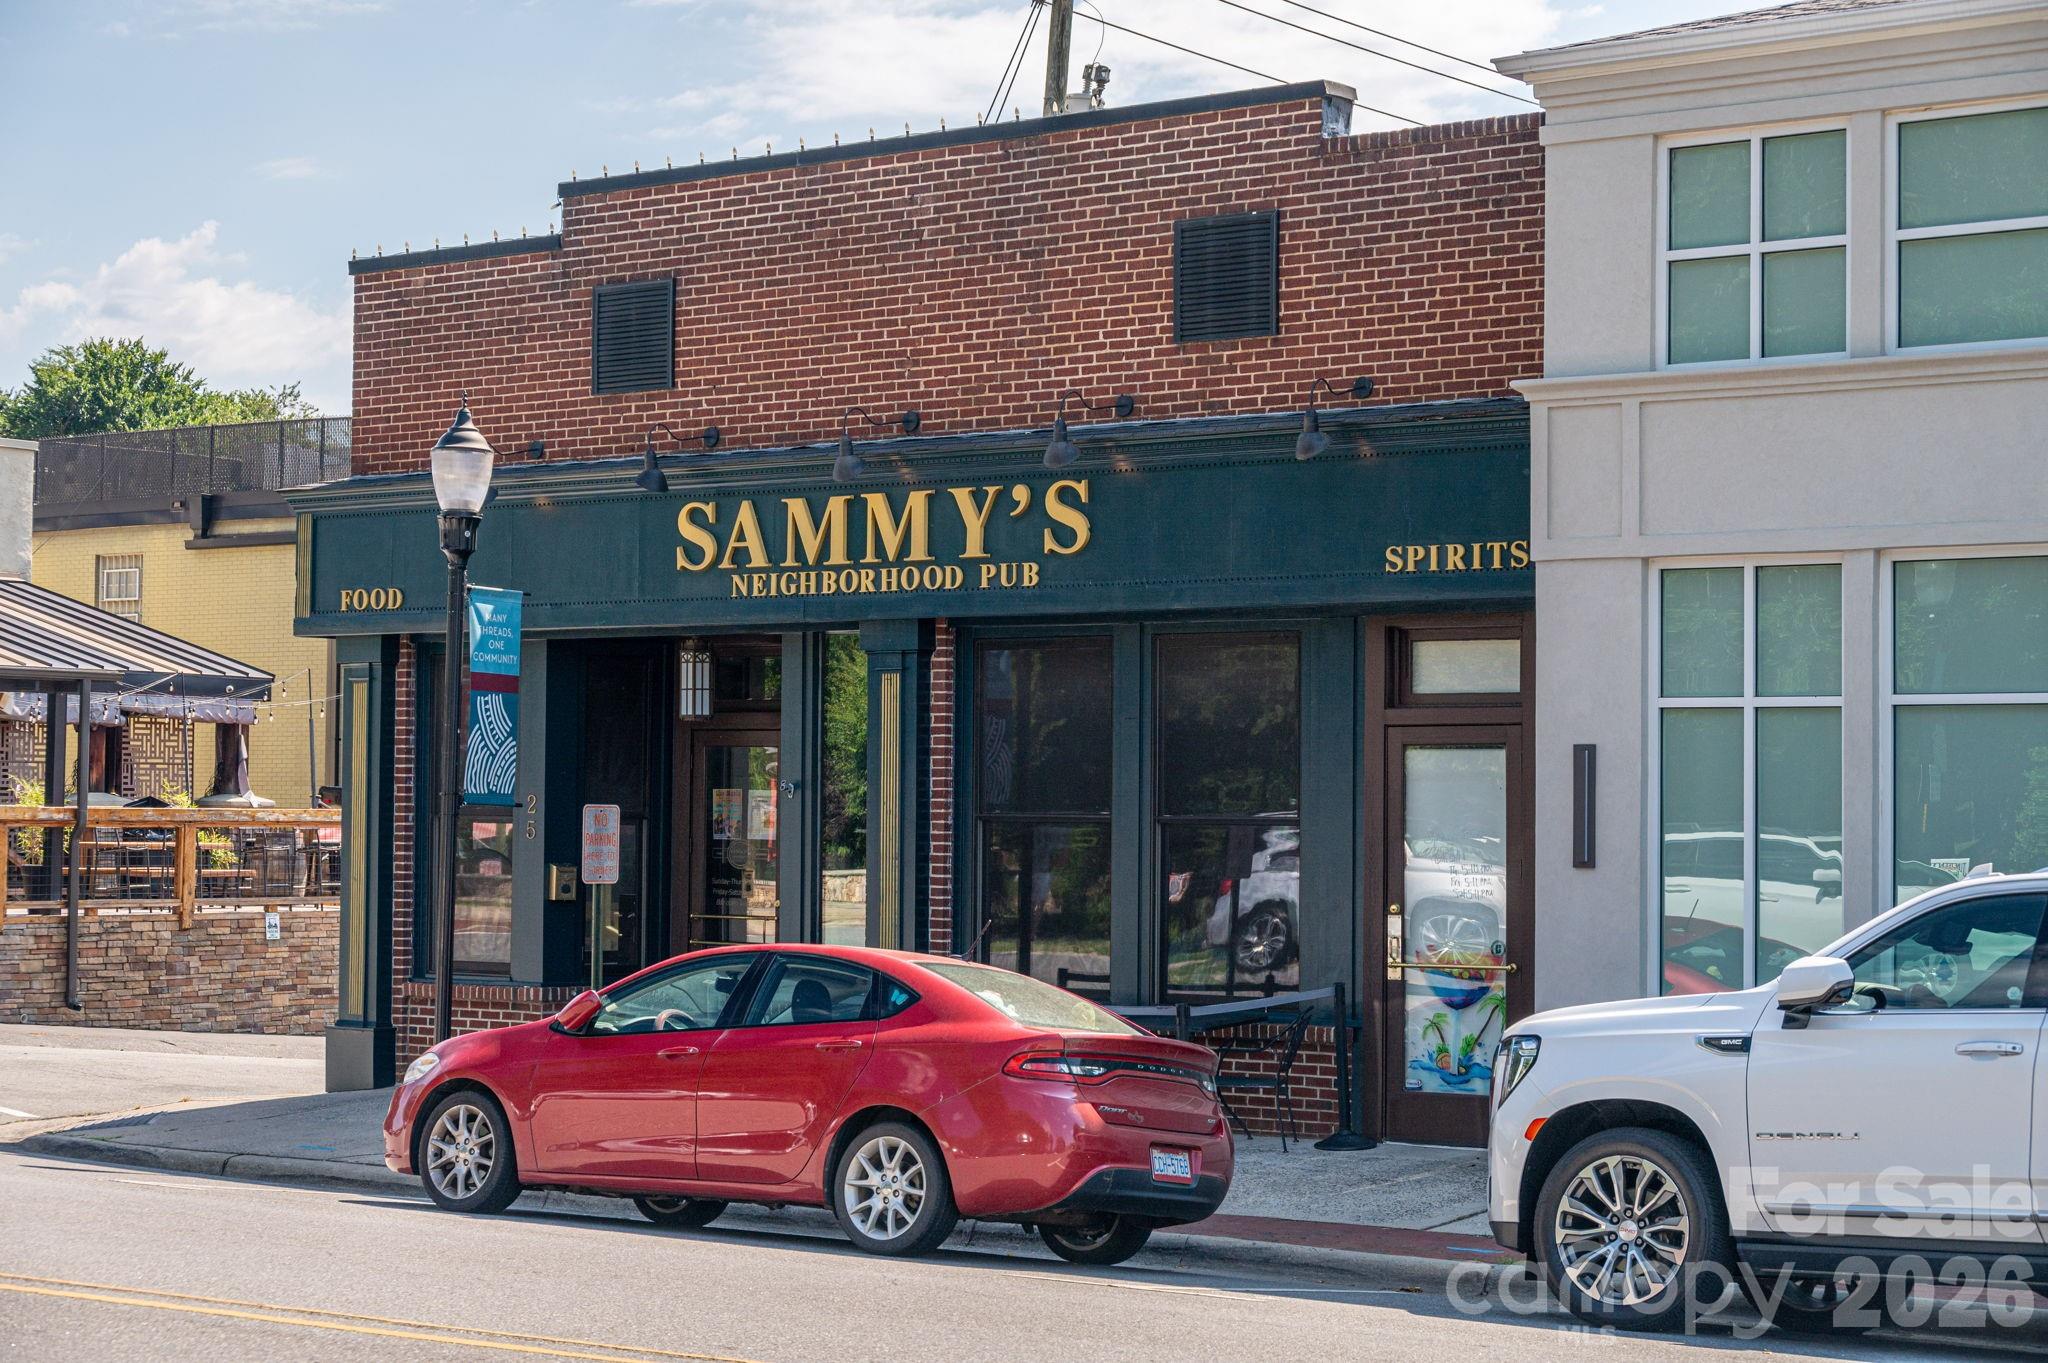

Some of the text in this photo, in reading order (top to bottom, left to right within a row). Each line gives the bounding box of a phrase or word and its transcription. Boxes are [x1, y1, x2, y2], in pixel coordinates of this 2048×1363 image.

[675, 479, 1091, 571] SAMMY'S
[1385, 540, 1529, 573] SPIRITS
[731, 562, 1040, 597] NEIGHBORHOOD PUB
[340, 588, 404, 611] FOOD
[486, 613, 507, 623] MANY
[488, 640, 504, 650] ONE
[472, 652, 518, 664] COMMUNITY
[594, 813, 609, 827] NO
[585, 832, 617, 847] PARKING
[1137, 1064, 1185, 1075] DODGE
[1756, 1132, 1859, 1141] DENALI
